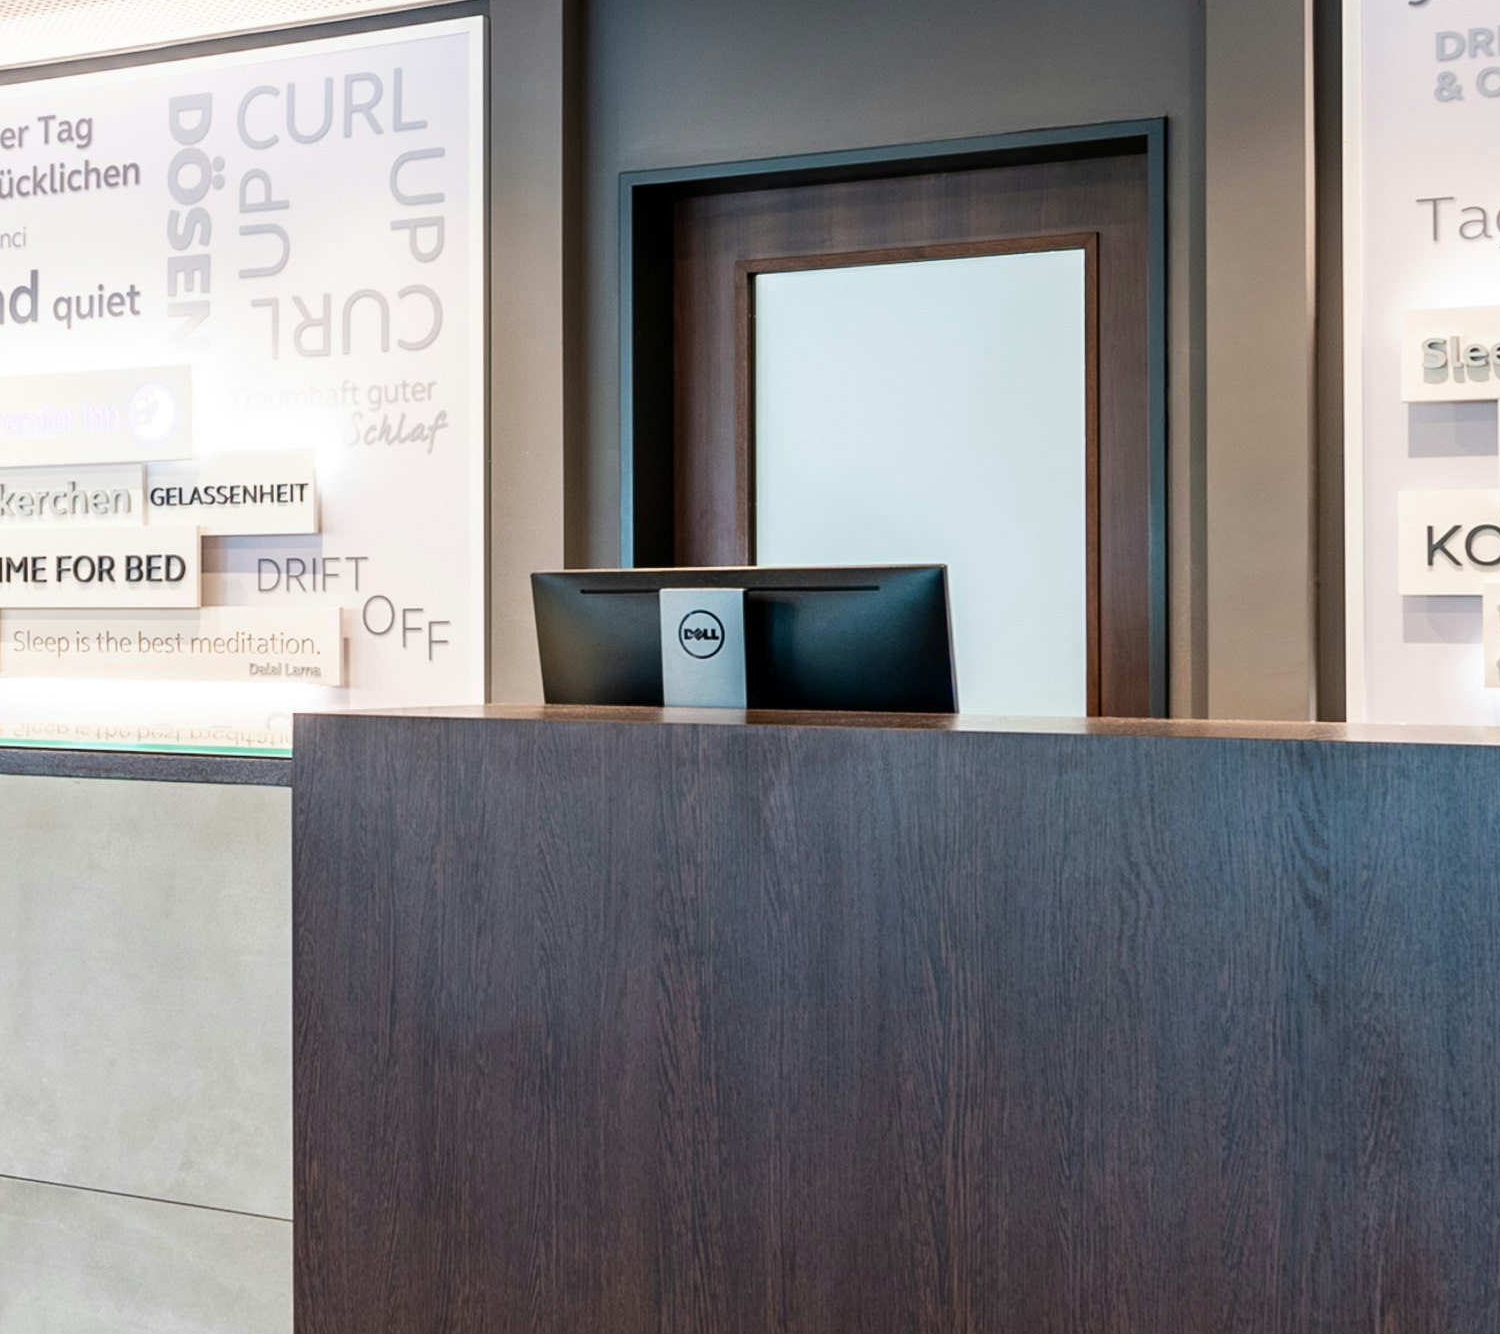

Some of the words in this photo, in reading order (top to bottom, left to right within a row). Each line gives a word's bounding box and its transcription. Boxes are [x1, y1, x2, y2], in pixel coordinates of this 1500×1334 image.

[1433, 71, 1463, 103] &
[237, 67, 428, 150] CURL
[37, 115, 94, 150] Tag
[389, 147, 445, 263] UP
[238, 168, 290, 280] UP
[53, 283, 140, 329] quiet
[251, 284, 443, 361] CURL
[368, 379, 437, 411] guter
[347, 410, 448, 455] Schlaf
[150, 483, 308, 507] GELASSENHEIT
[56, 555, 116, 583] FOR
[125, 554, 186, 583] BED
[257, 556, 369, 593] DRIFT
[13, 630, 70, 657] Sleep
[76, 631, 91, 653] is
[97, 630, 132, 654] the
[138, 630, 184, 655] best
[191, 632, 321, 655] meditation.
[362, 594, 451, 661] OFF
[285, 663, 321, 676] Lama
